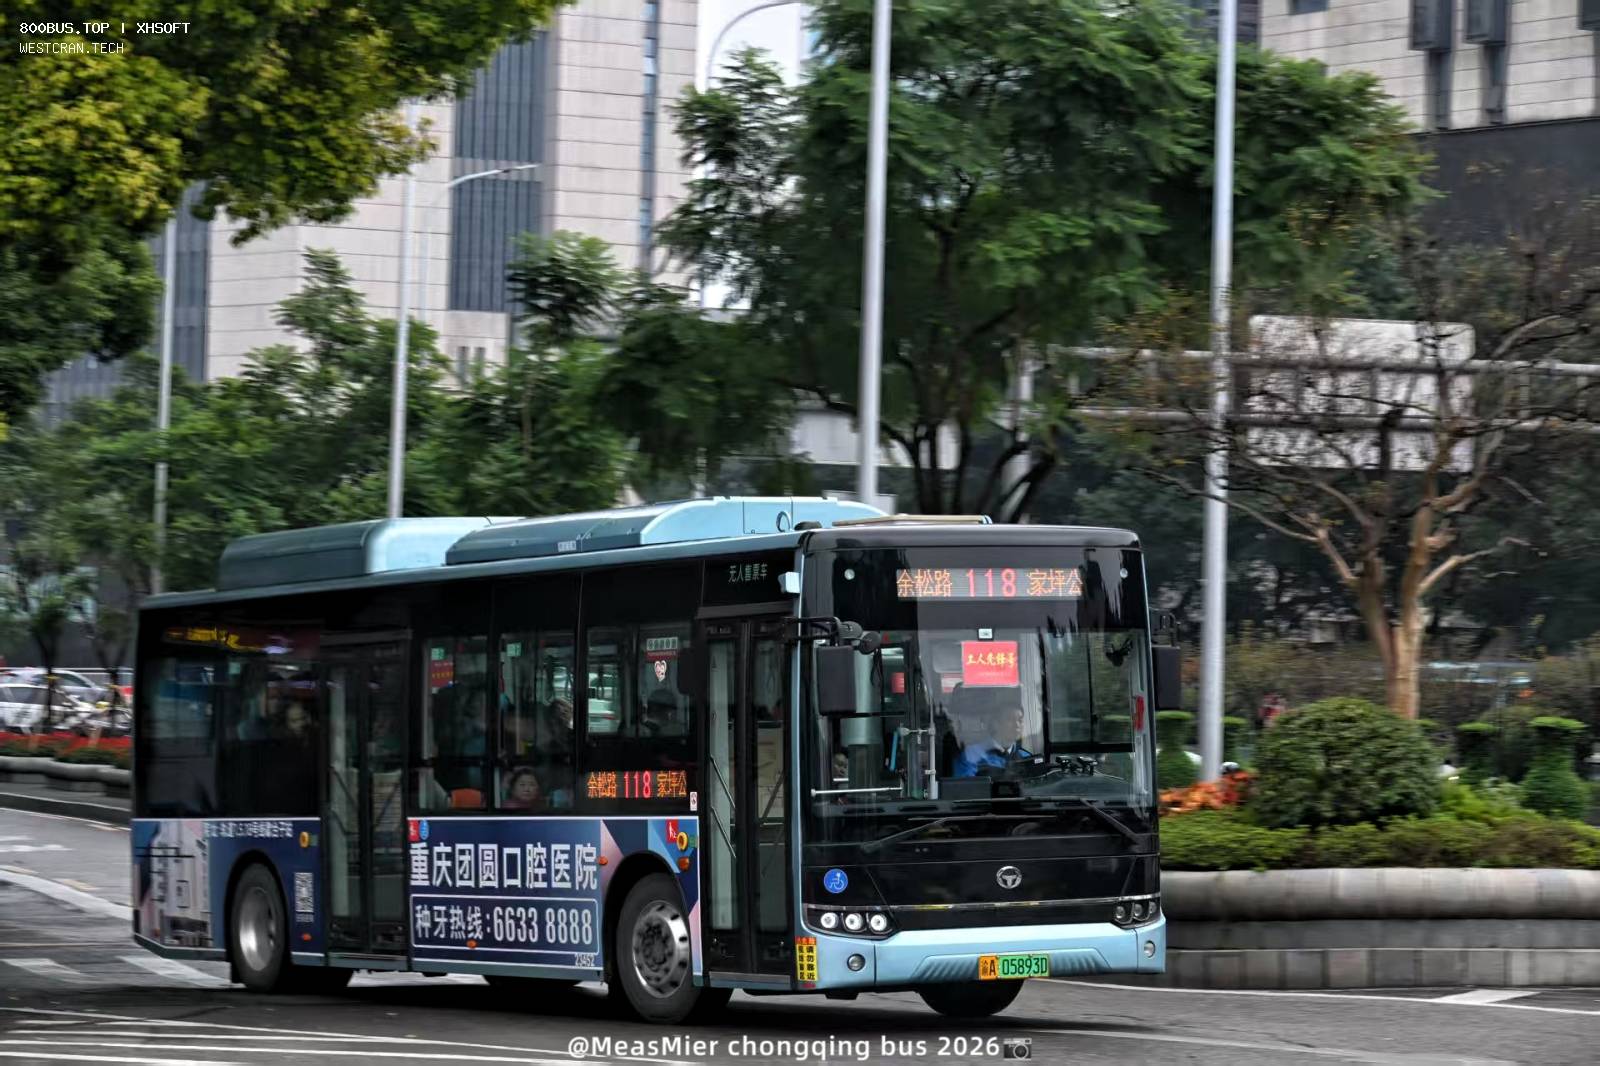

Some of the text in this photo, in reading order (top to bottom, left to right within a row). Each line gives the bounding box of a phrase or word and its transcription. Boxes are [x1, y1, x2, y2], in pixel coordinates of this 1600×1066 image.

[728, 562, 768, 582] 无人售票车
[896, 568, 1083, 597] 余松路 118 家坪公
[966, 651, 1017, 668] 工人先锋号
[587, 770, 687, 798] 余松路 118 家坪公
[409, 842, 598, 890] 重庆团圆口腔医院
[545, 907, 593, 945] 8888
